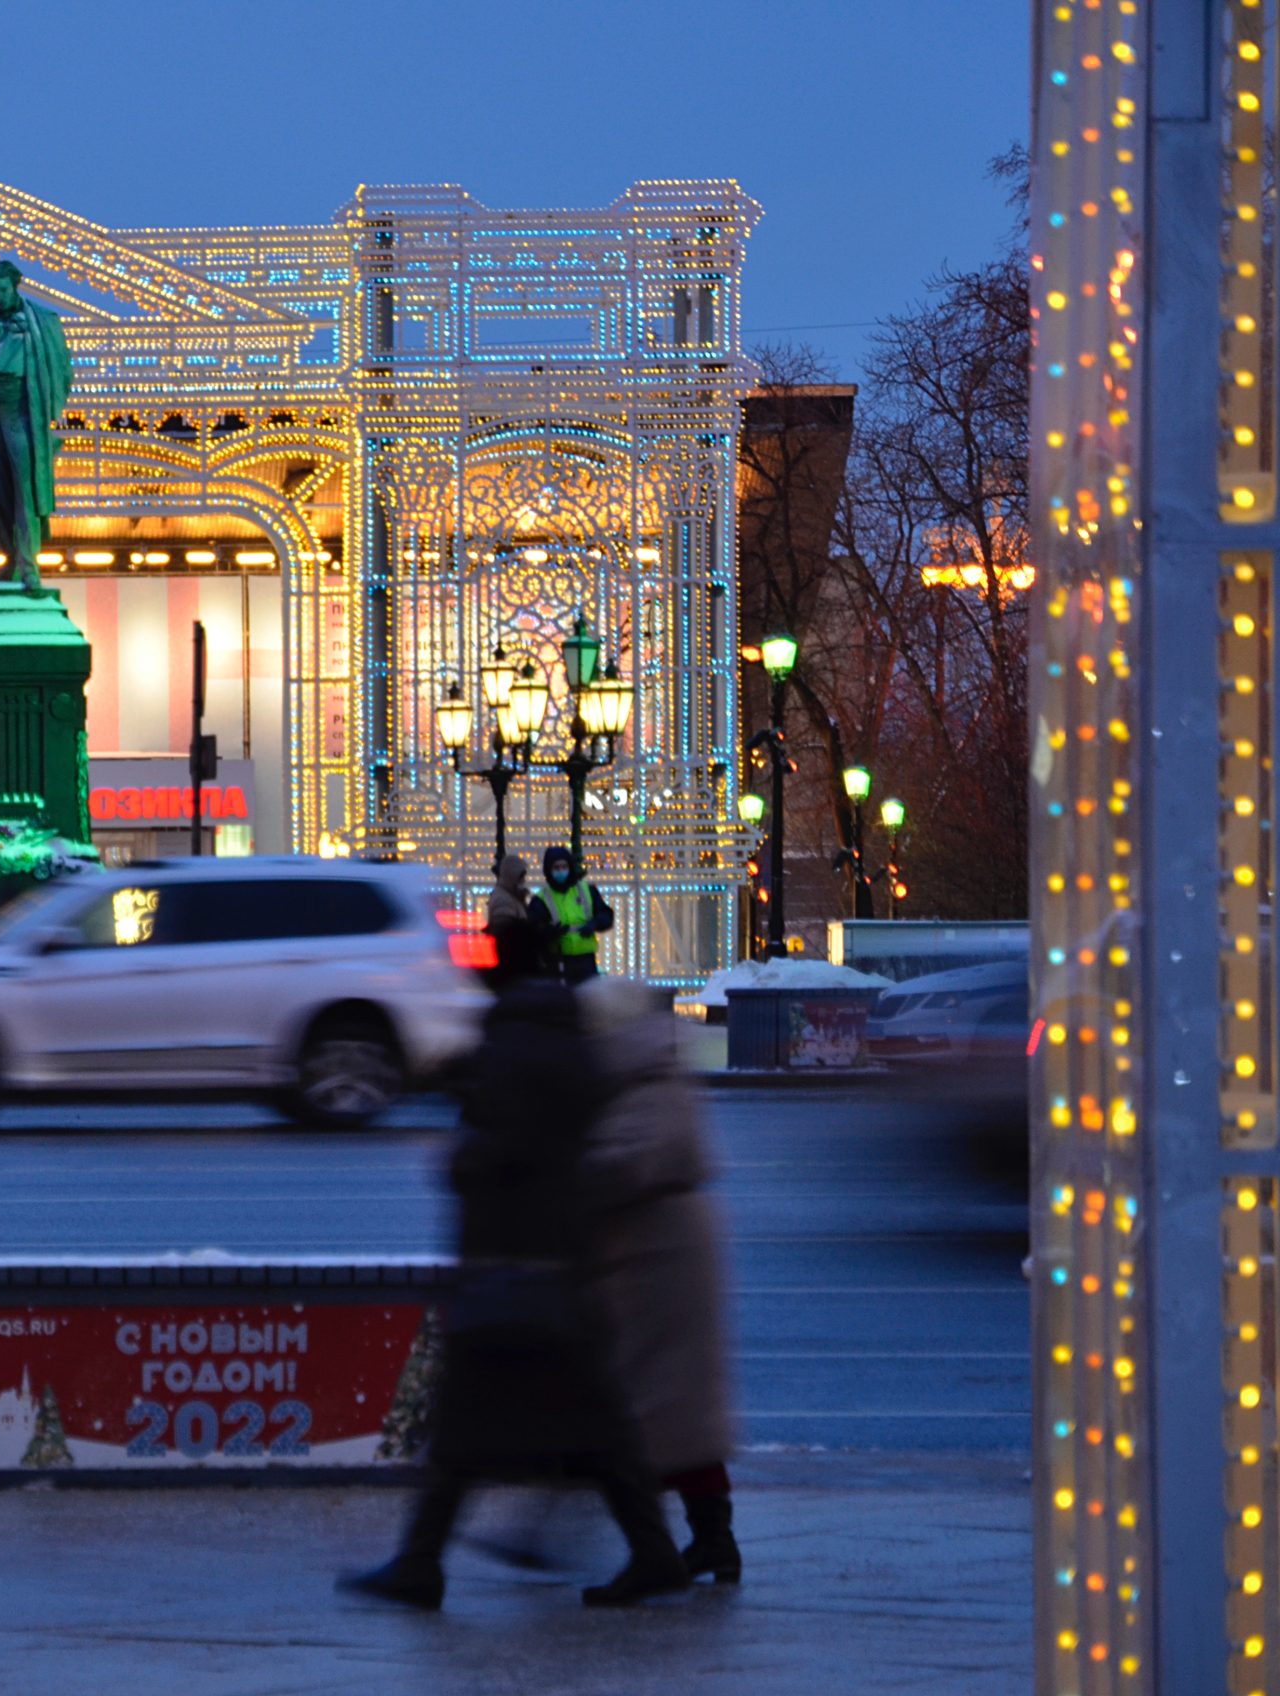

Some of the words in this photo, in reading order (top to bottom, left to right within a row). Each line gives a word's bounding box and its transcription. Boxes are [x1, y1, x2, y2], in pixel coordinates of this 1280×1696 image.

[150, 1321, 309, 1355] НОВЫМ
[141, 1360, 298, 1393] ГОДОМ!
[125, 1399, 314, 1459] 2022
